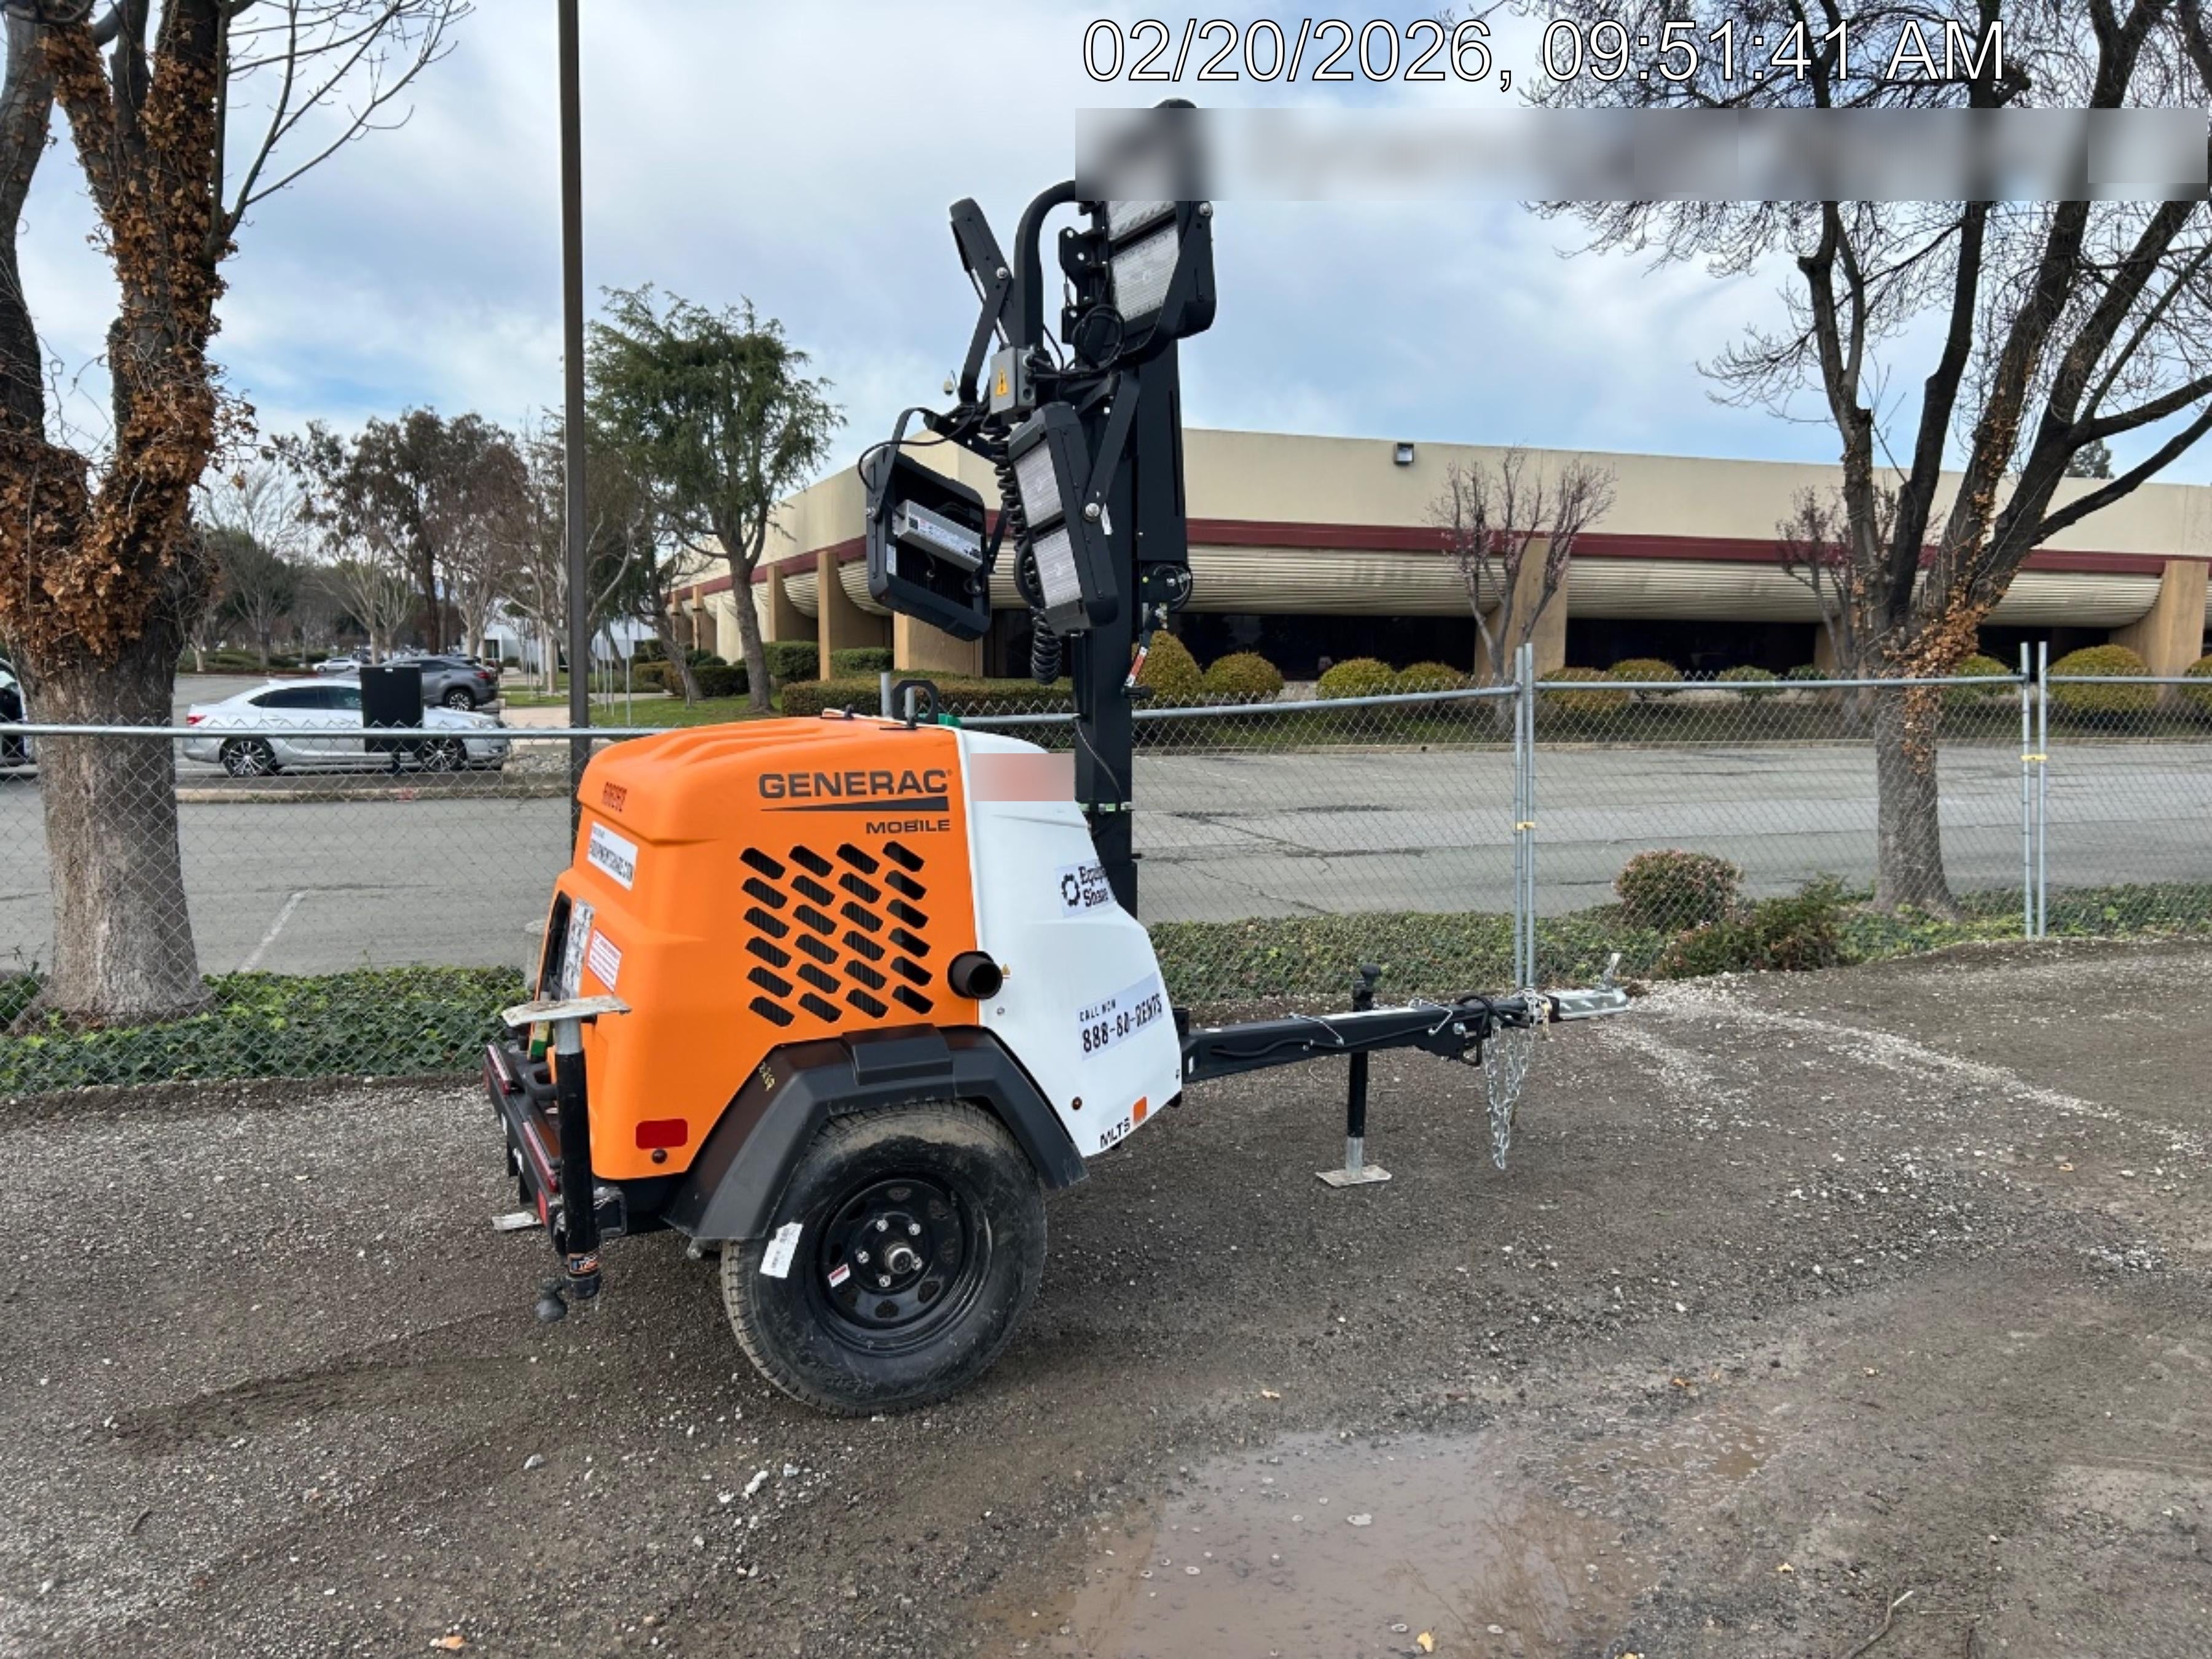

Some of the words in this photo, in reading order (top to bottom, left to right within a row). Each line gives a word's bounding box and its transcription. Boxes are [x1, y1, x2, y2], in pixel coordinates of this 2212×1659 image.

[758, 769, 949, 799] GENERAC
[866, 819, 951, 834] MOBILE
[1079, 1006, 1099, 1022] CALL
